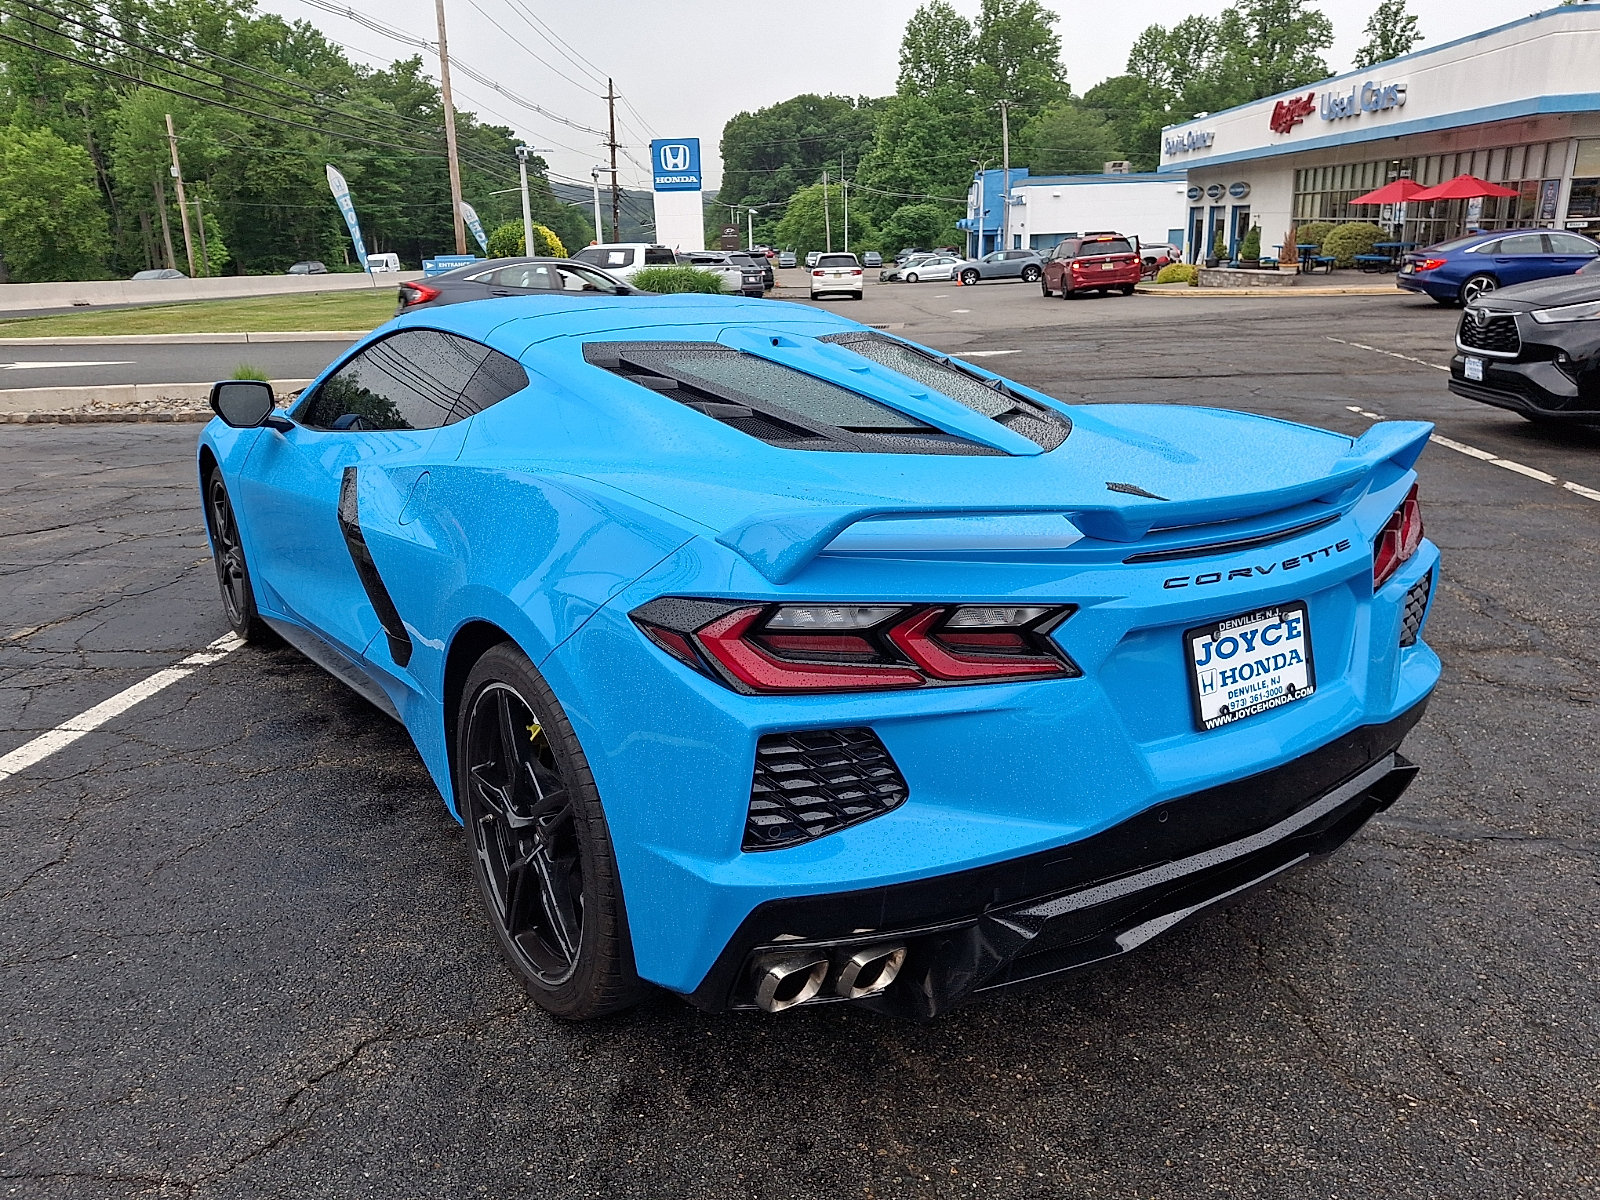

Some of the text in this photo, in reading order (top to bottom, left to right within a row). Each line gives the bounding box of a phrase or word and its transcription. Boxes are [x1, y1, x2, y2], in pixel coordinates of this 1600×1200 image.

[1320, 85, 1360, 120] Used
[1360, 81, 1407, 113] Cars
[1163, 538, 1352, 589] CORVETTE
[1266, 607, 1282, 619] N.J.
[1196, 617, 1302, 666] JOYCE
[1219, 649, 1304, 688] HONDA
[1227, 675, 1281, 700] DENVILLE, NJ
[1205, 686, 1314, 729] WWW.JOYCEHONDA.COM
[1228, 686, 1283, 711] (973) 361-3000
